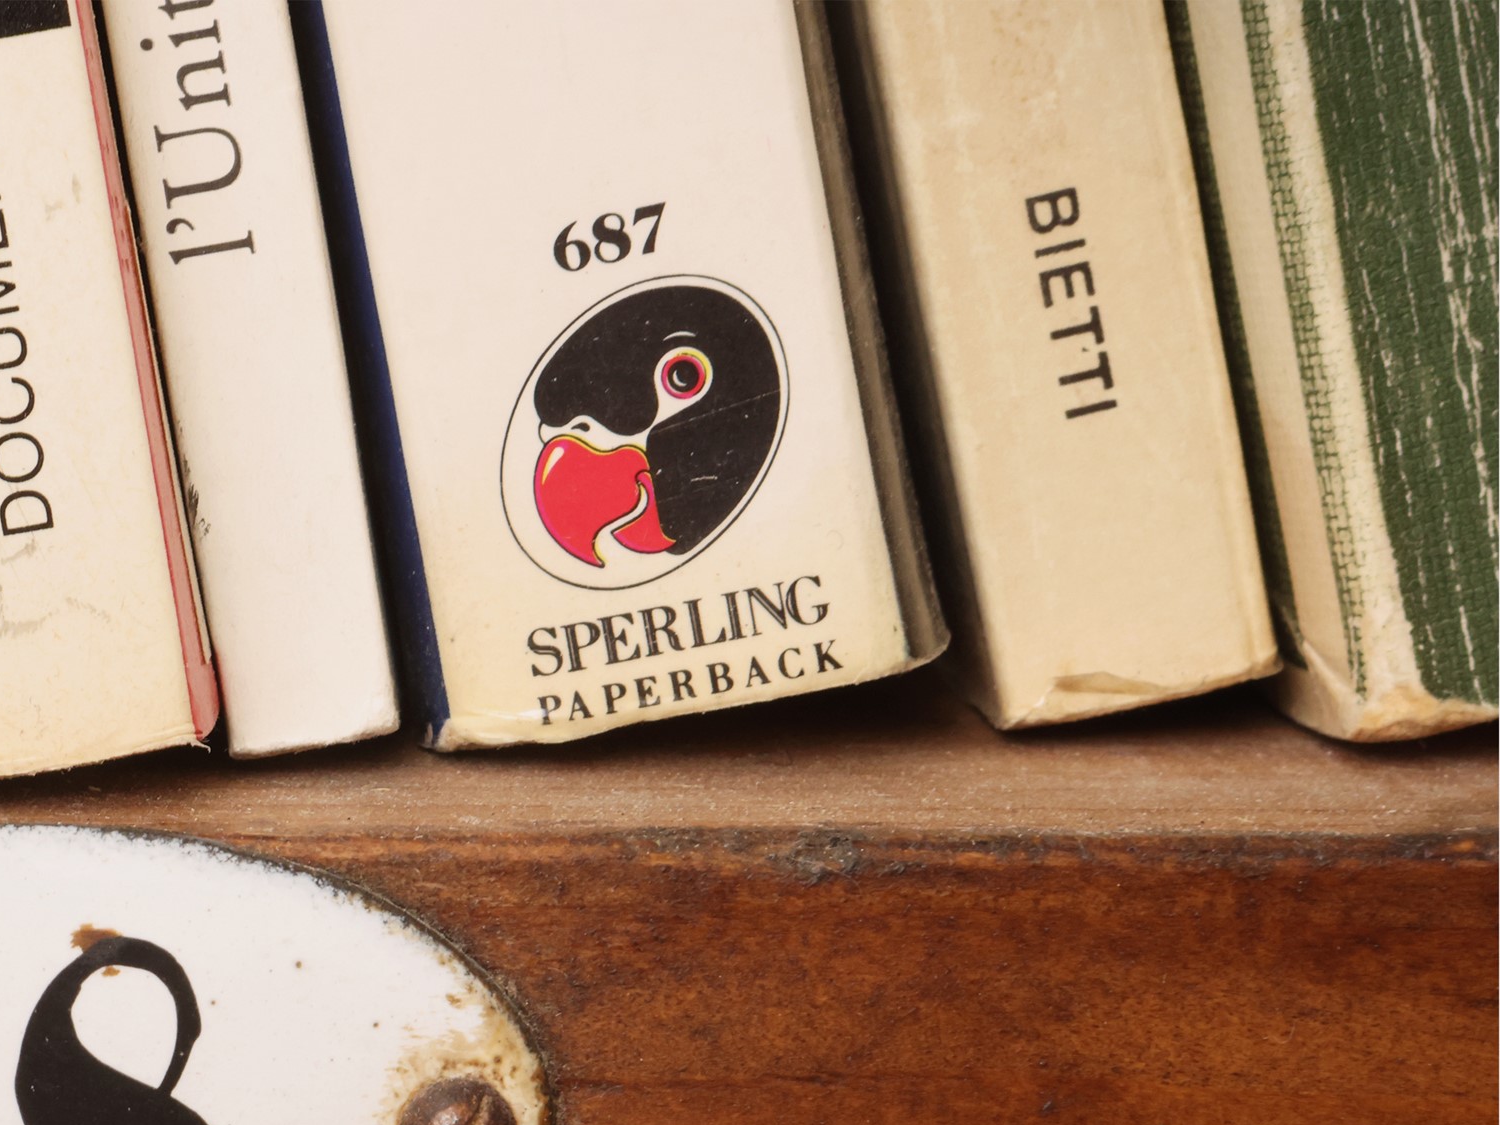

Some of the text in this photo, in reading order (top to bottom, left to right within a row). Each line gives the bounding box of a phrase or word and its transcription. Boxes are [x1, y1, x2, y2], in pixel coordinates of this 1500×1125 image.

[553, 202, 666, 272] 687
[1025, 187, 1117, 419] BIETTI
[526, 575, 831, 677] SPERLING
[537, 639, 844, 725] PAPERBACK
